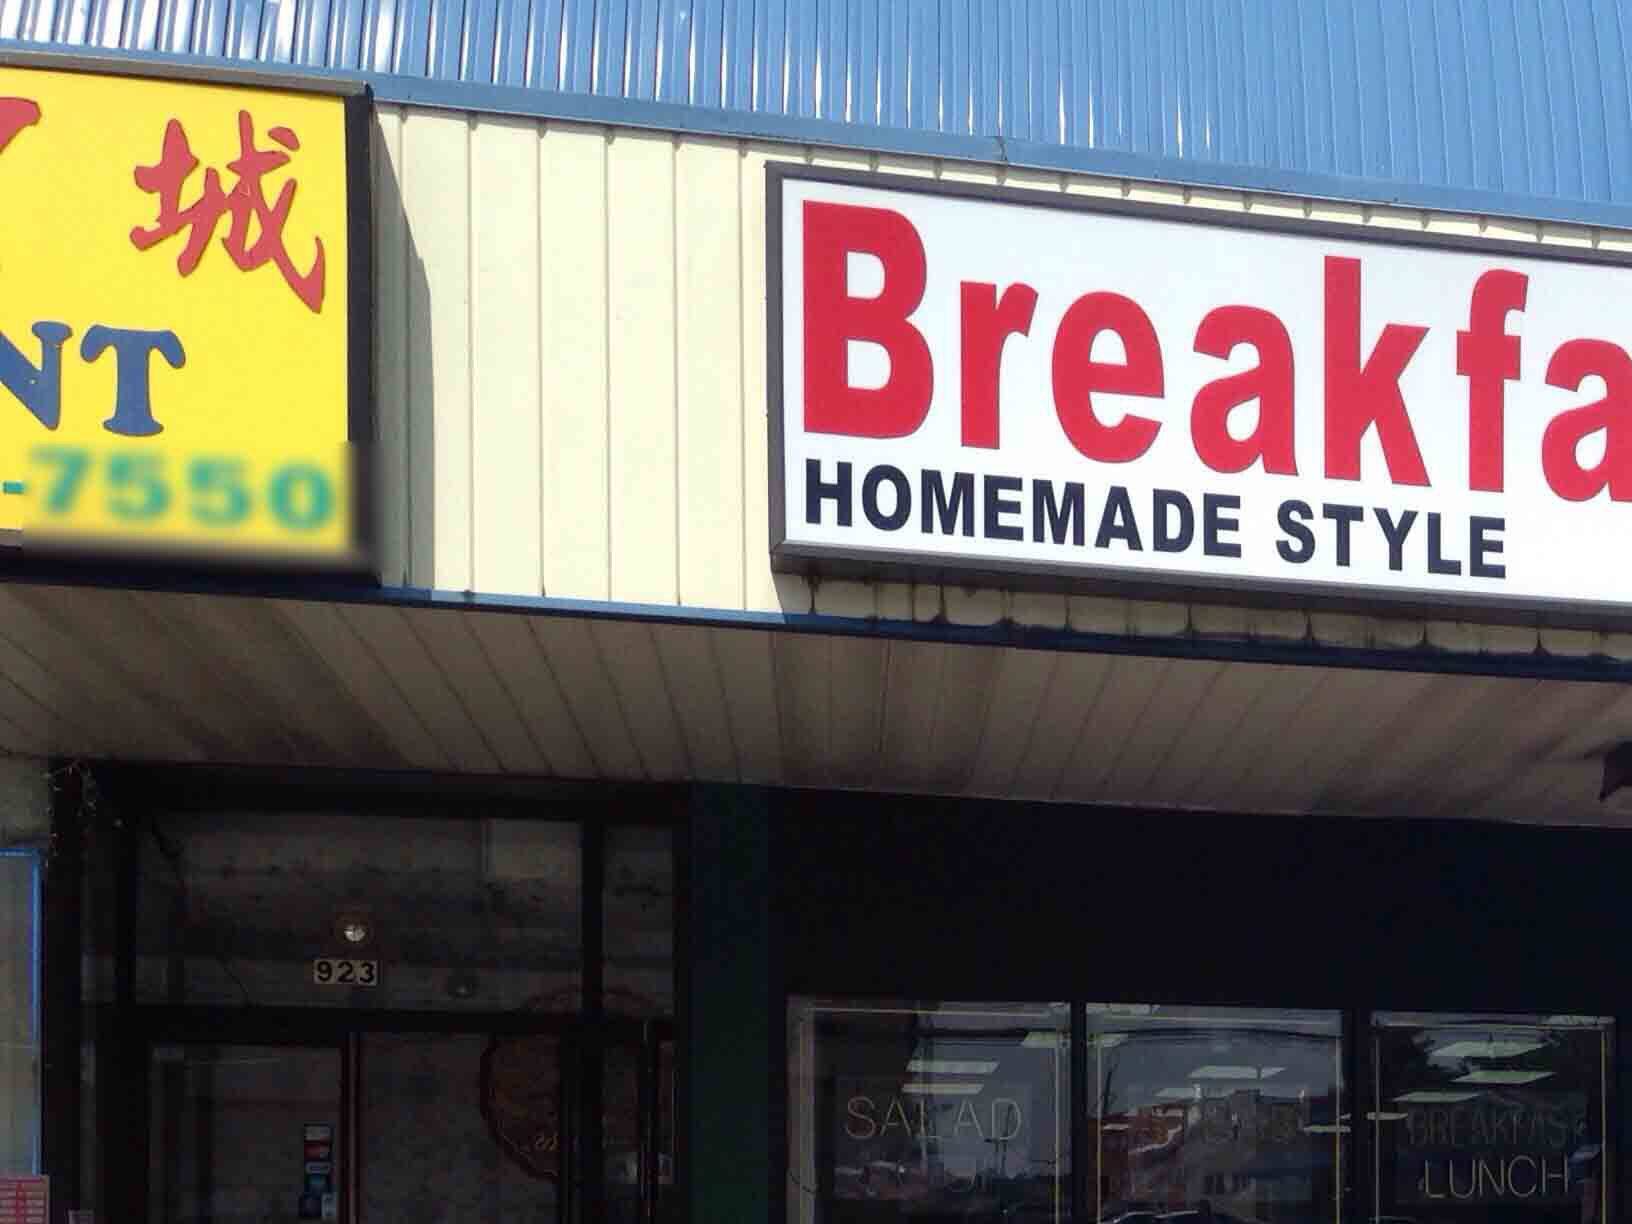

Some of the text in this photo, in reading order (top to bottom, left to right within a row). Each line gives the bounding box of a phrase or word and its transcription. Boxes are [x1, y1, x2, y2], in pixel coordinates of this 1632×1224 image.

[805, 457, 1507, 580] HOMEMADE STYLE
[317, 960, 375, 983] 923
[846, 1096, 1024, 1141] SALAD
[1424, 1153, 1569, 1200] LUNCH
